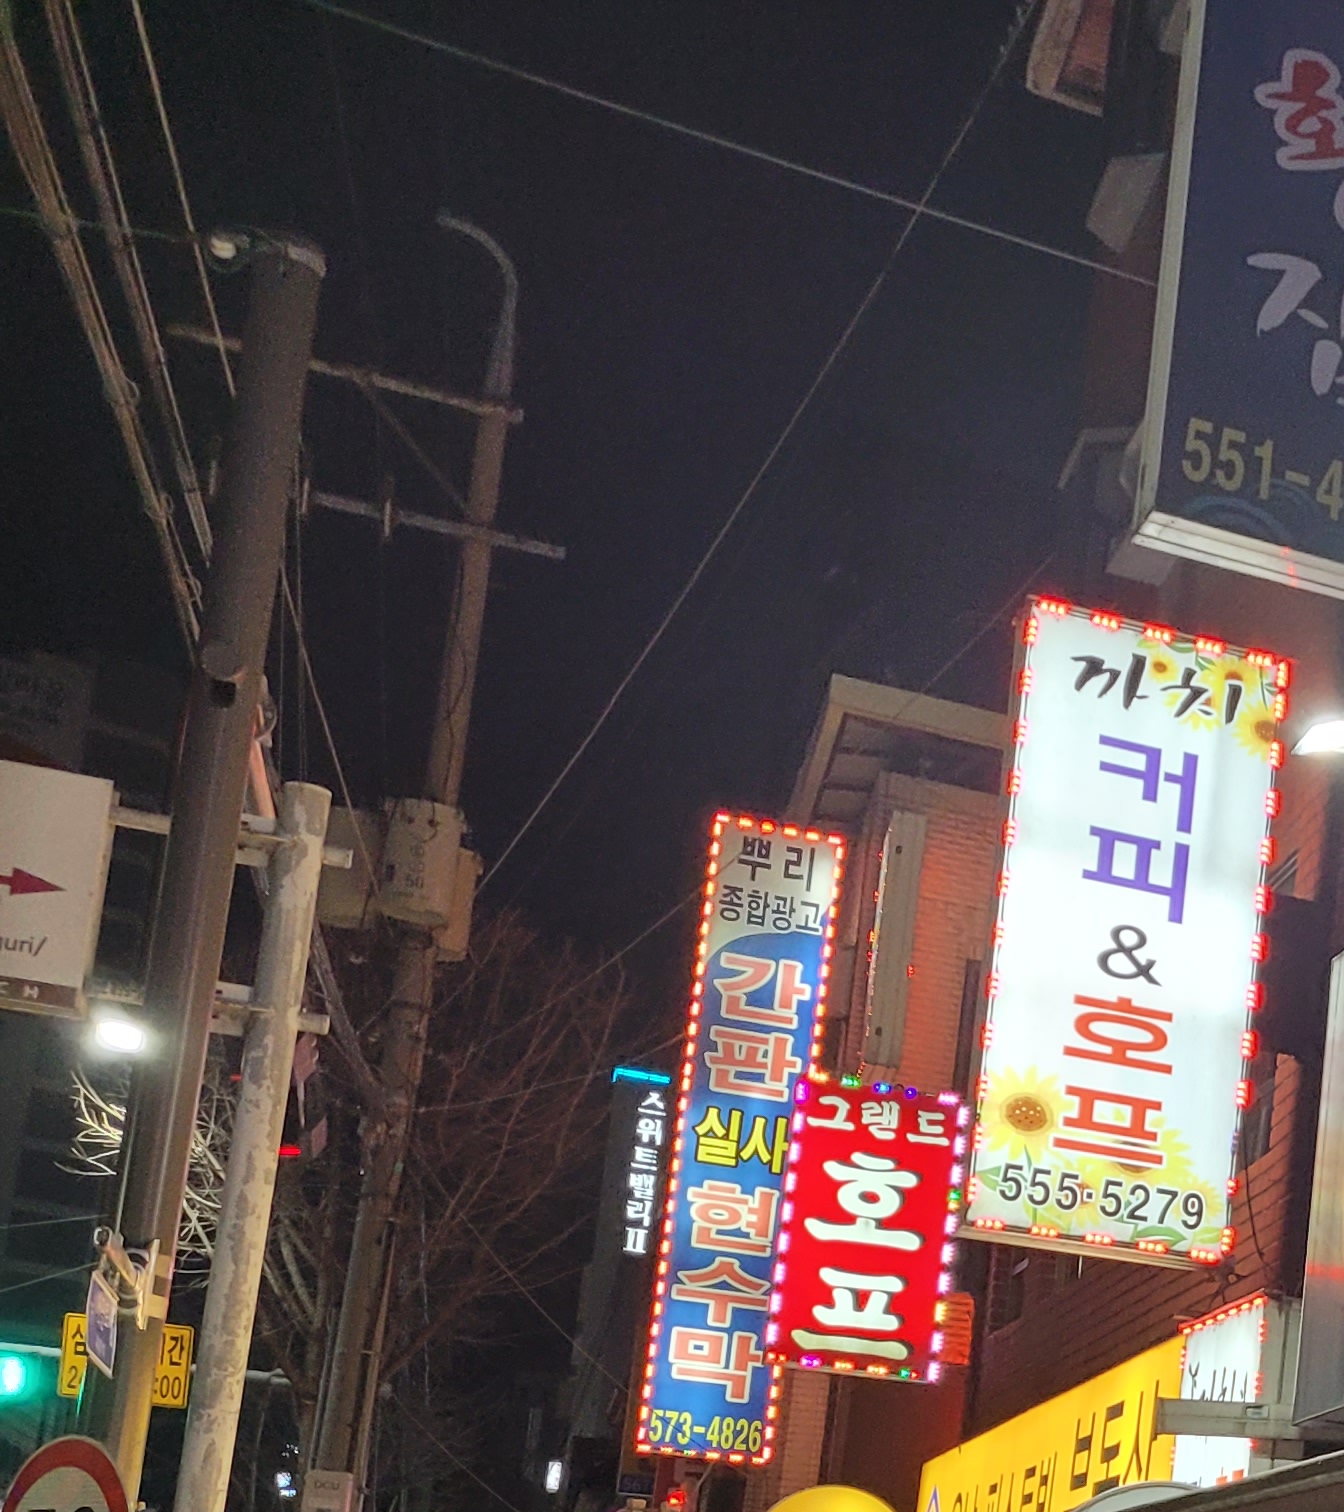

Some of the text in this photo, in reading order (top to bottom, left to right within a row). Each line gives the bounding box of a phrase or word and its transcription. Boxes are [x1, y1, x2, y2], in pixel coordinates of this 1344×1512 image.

[1070, 652, 1244, 725] 까치
[738, 835, 816, 893] 뿌리
[718, 884, 824, 935] 종합광고
[704, 952, 811, 1103] 간판
[693, 1106, 790, 1175] 실사
[807, 1095, 950, 1147] 그랜드
[790, 1151, 923, 1361] 호프
[668, 1179, 779, 1403] 현수막
[648, 1408, 763, 1453] 573-4826
